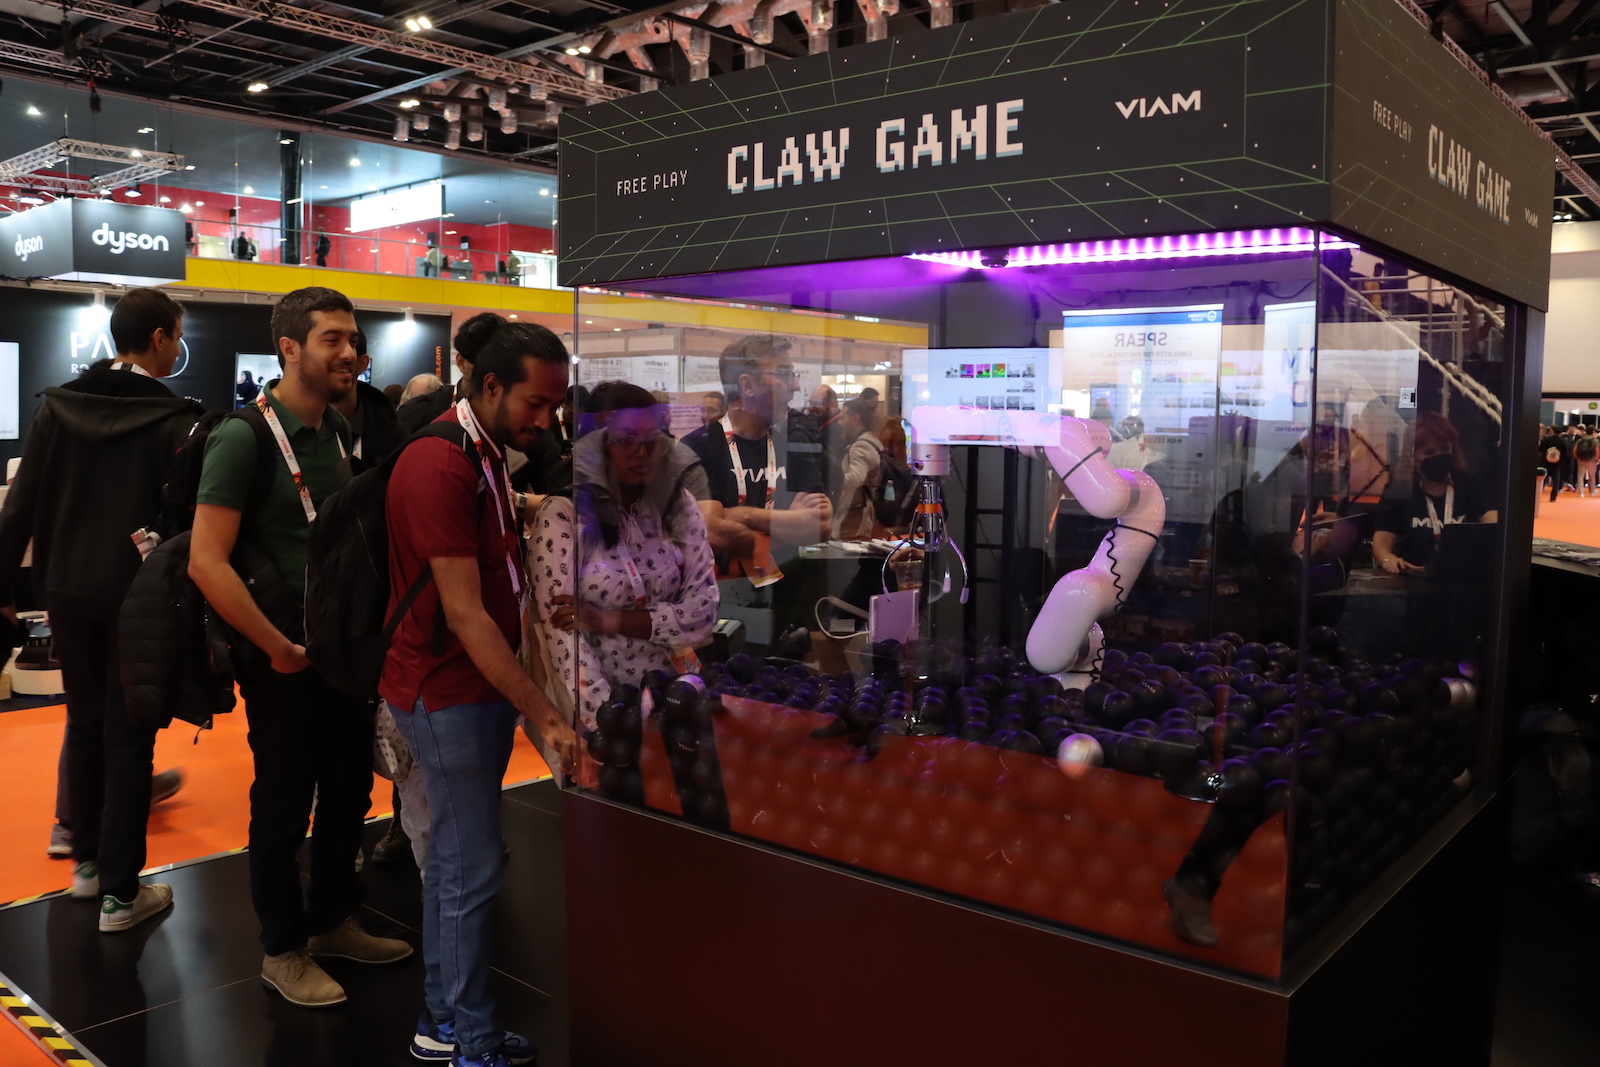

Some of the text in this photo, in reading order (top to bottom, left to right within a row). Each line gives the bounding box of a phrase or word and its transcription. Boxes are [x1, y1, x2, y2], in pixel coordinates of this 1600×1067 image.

[1115, 90, 1202, 120] VIAM
[1373, 100, 1413, 143] FREE PLAY
[727, 98, 1024, 195] CLAW GAME
[616, 169, 688, 197] FREE PLAY
[1427, 123, 1511, 226] CLAW GAME
[15, 234, 43, 261] dyson
[92, 222, 169, 255] dyson
